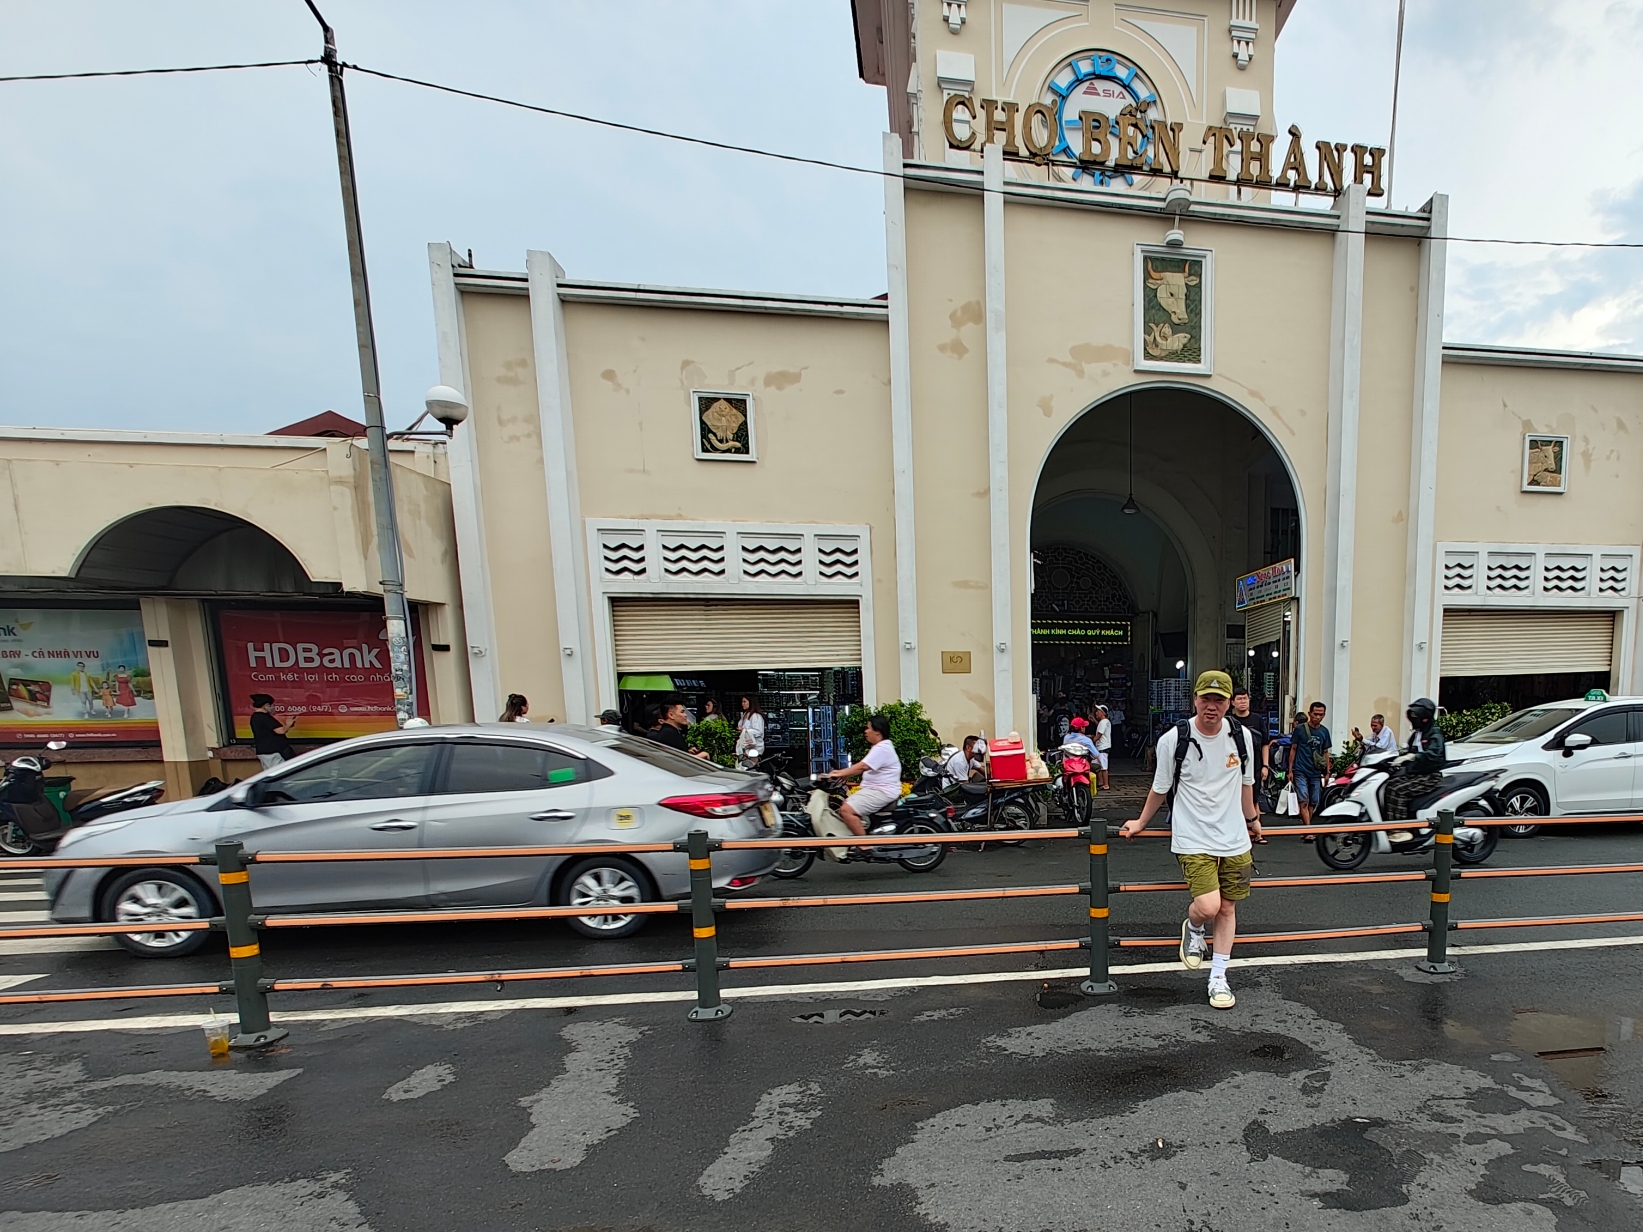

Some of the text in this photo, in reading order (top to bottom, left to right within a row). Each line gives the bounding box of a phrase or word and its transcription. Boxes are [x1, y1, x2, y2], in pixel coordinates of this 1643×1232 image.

[1091, 53, 1117, 77] 12
[943, 93, 1387, 197] CHỢ BẾN THÀNH
[1101, 627, 1124, 636] KHÁCH
[47, 648, 71, 659] NHÀ
[72, 650, 83, 659] VI
[85, 650, 99, 659] VU
[247, 642, 383, 669] HDBank
[251, 671, 276, 681] Cam
[280, 671, 299, 681] kết
[304, 672, 319, 683] lợi
[344, 674, 365, 682] cao
[308, 704, 332, 713] (24/7)
